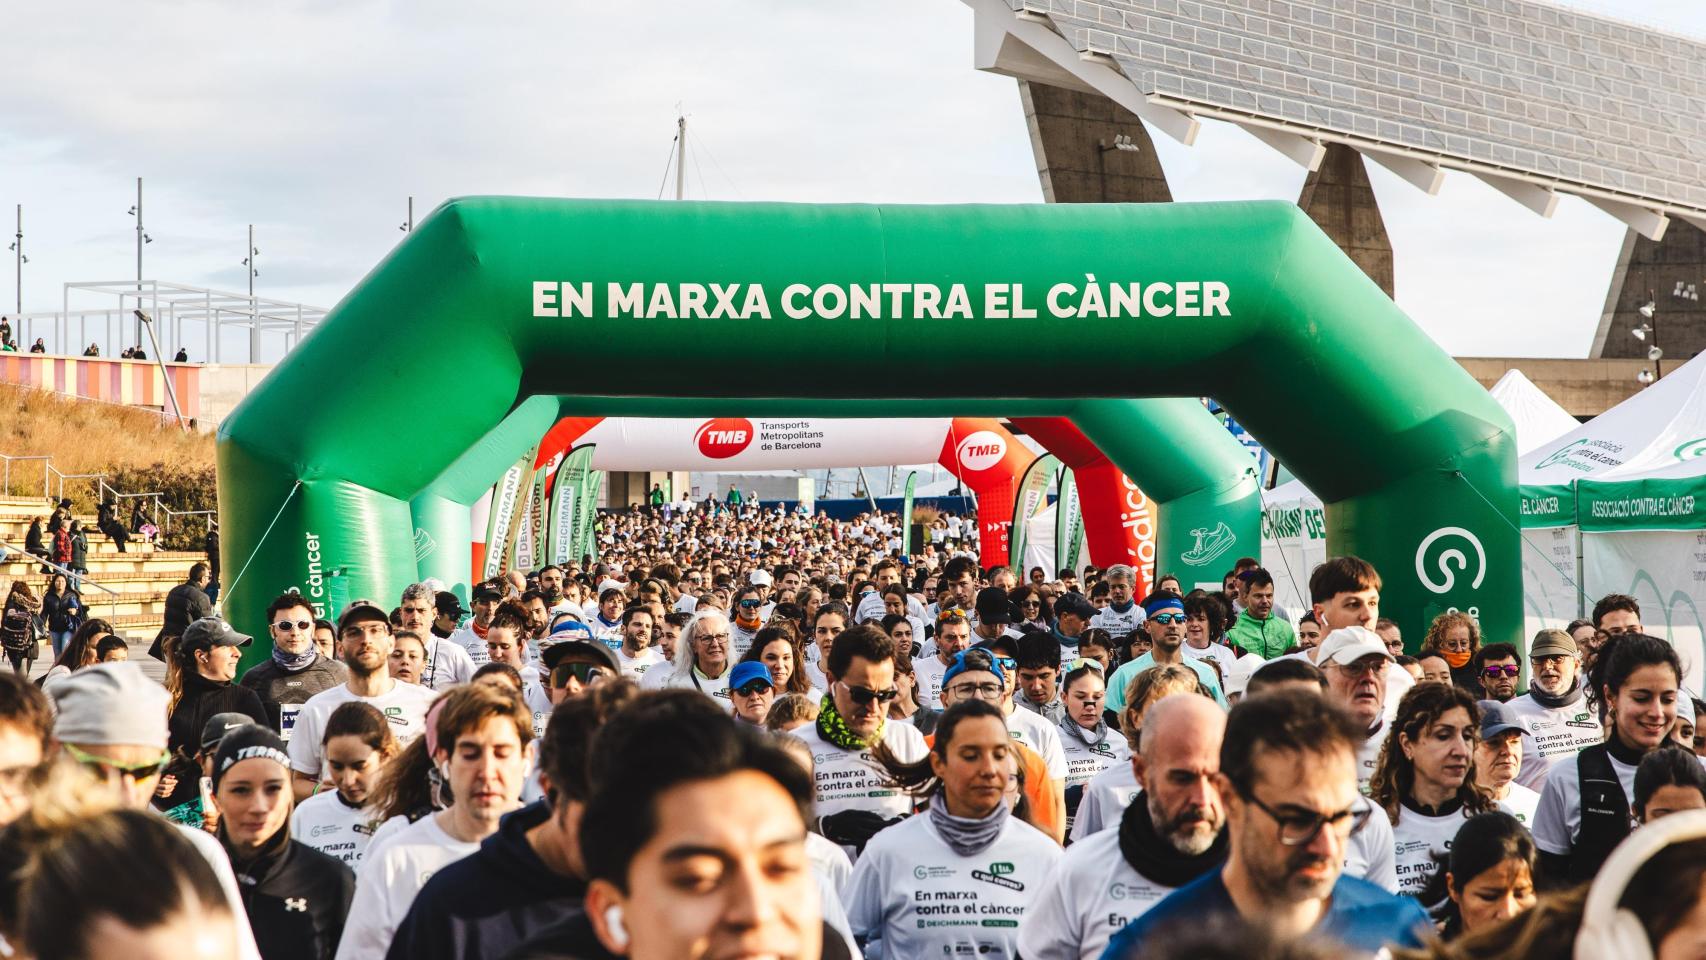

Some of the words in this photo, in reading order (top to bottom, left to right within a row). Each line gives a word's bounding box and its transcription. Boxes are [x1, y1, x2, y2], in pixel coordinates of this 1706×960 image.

[532, 281, 593, 318] EN
[607, 282, 772, 319] MARXA
[780, 283, 974, 320] CONTRA
[984, 283, 1038, 319] EL
[1046, 273, 1232, 319] CÀNCER
[760, 421, 810, 431] Transports
[707, 430, 748, 445] TMB
[760, 431, 824, 441] Metropolitans
[760, 441, 773, 451] de
[775, 441, 822, 451] Barcelona
[967, 444, 1000, 457] TMB
[1522, 499, 1531, 515] EL
[1531, 494, 1559, 515] CÀNCER
[1592, 495, 1630, 518] ASSOCIACIÓ
[1631, 498, 1658, 516] CONTRA
[1658, 499, 1667, 516] EL
[1667, 492, 1695, 515] CÀNCER
[492, 468, 518, 560] DEICHMANN
[560, 487, 571, 555] DEICHMANN
[572, 496, 582, 561] mxTothom
[305, 532, 324, 599] càncer
[314, 602, 326, 619] el
[1547, 732, 1573, 741] marxa
[1537, 741, 1564, 750] contra
[1565, 738, 1574, 746] el
[815, 771, 829, 781] En
[832, 769, 866, 779] marxa
[816, 781, 853, 792] contra
[855, 778, 865, 788] el
[825, 792, 866, 801] DEICHMANN
[323, 842, 356, 853] marxa
[343, 851, 354, 861] el
[1396, 864, 1411, 875] En
[1413, 861, 1437, 872] mar
[915, 890, 931, 901] En
[935, 890, 978, 900] marxa
[916, 903, 960, 915] contra
[964, 902, 977, 914] el
[981, 902, 1024, 915] càncer
[926, 919, 978, 927] DEICHMANN
[1108, 913, 1127, 927] En
